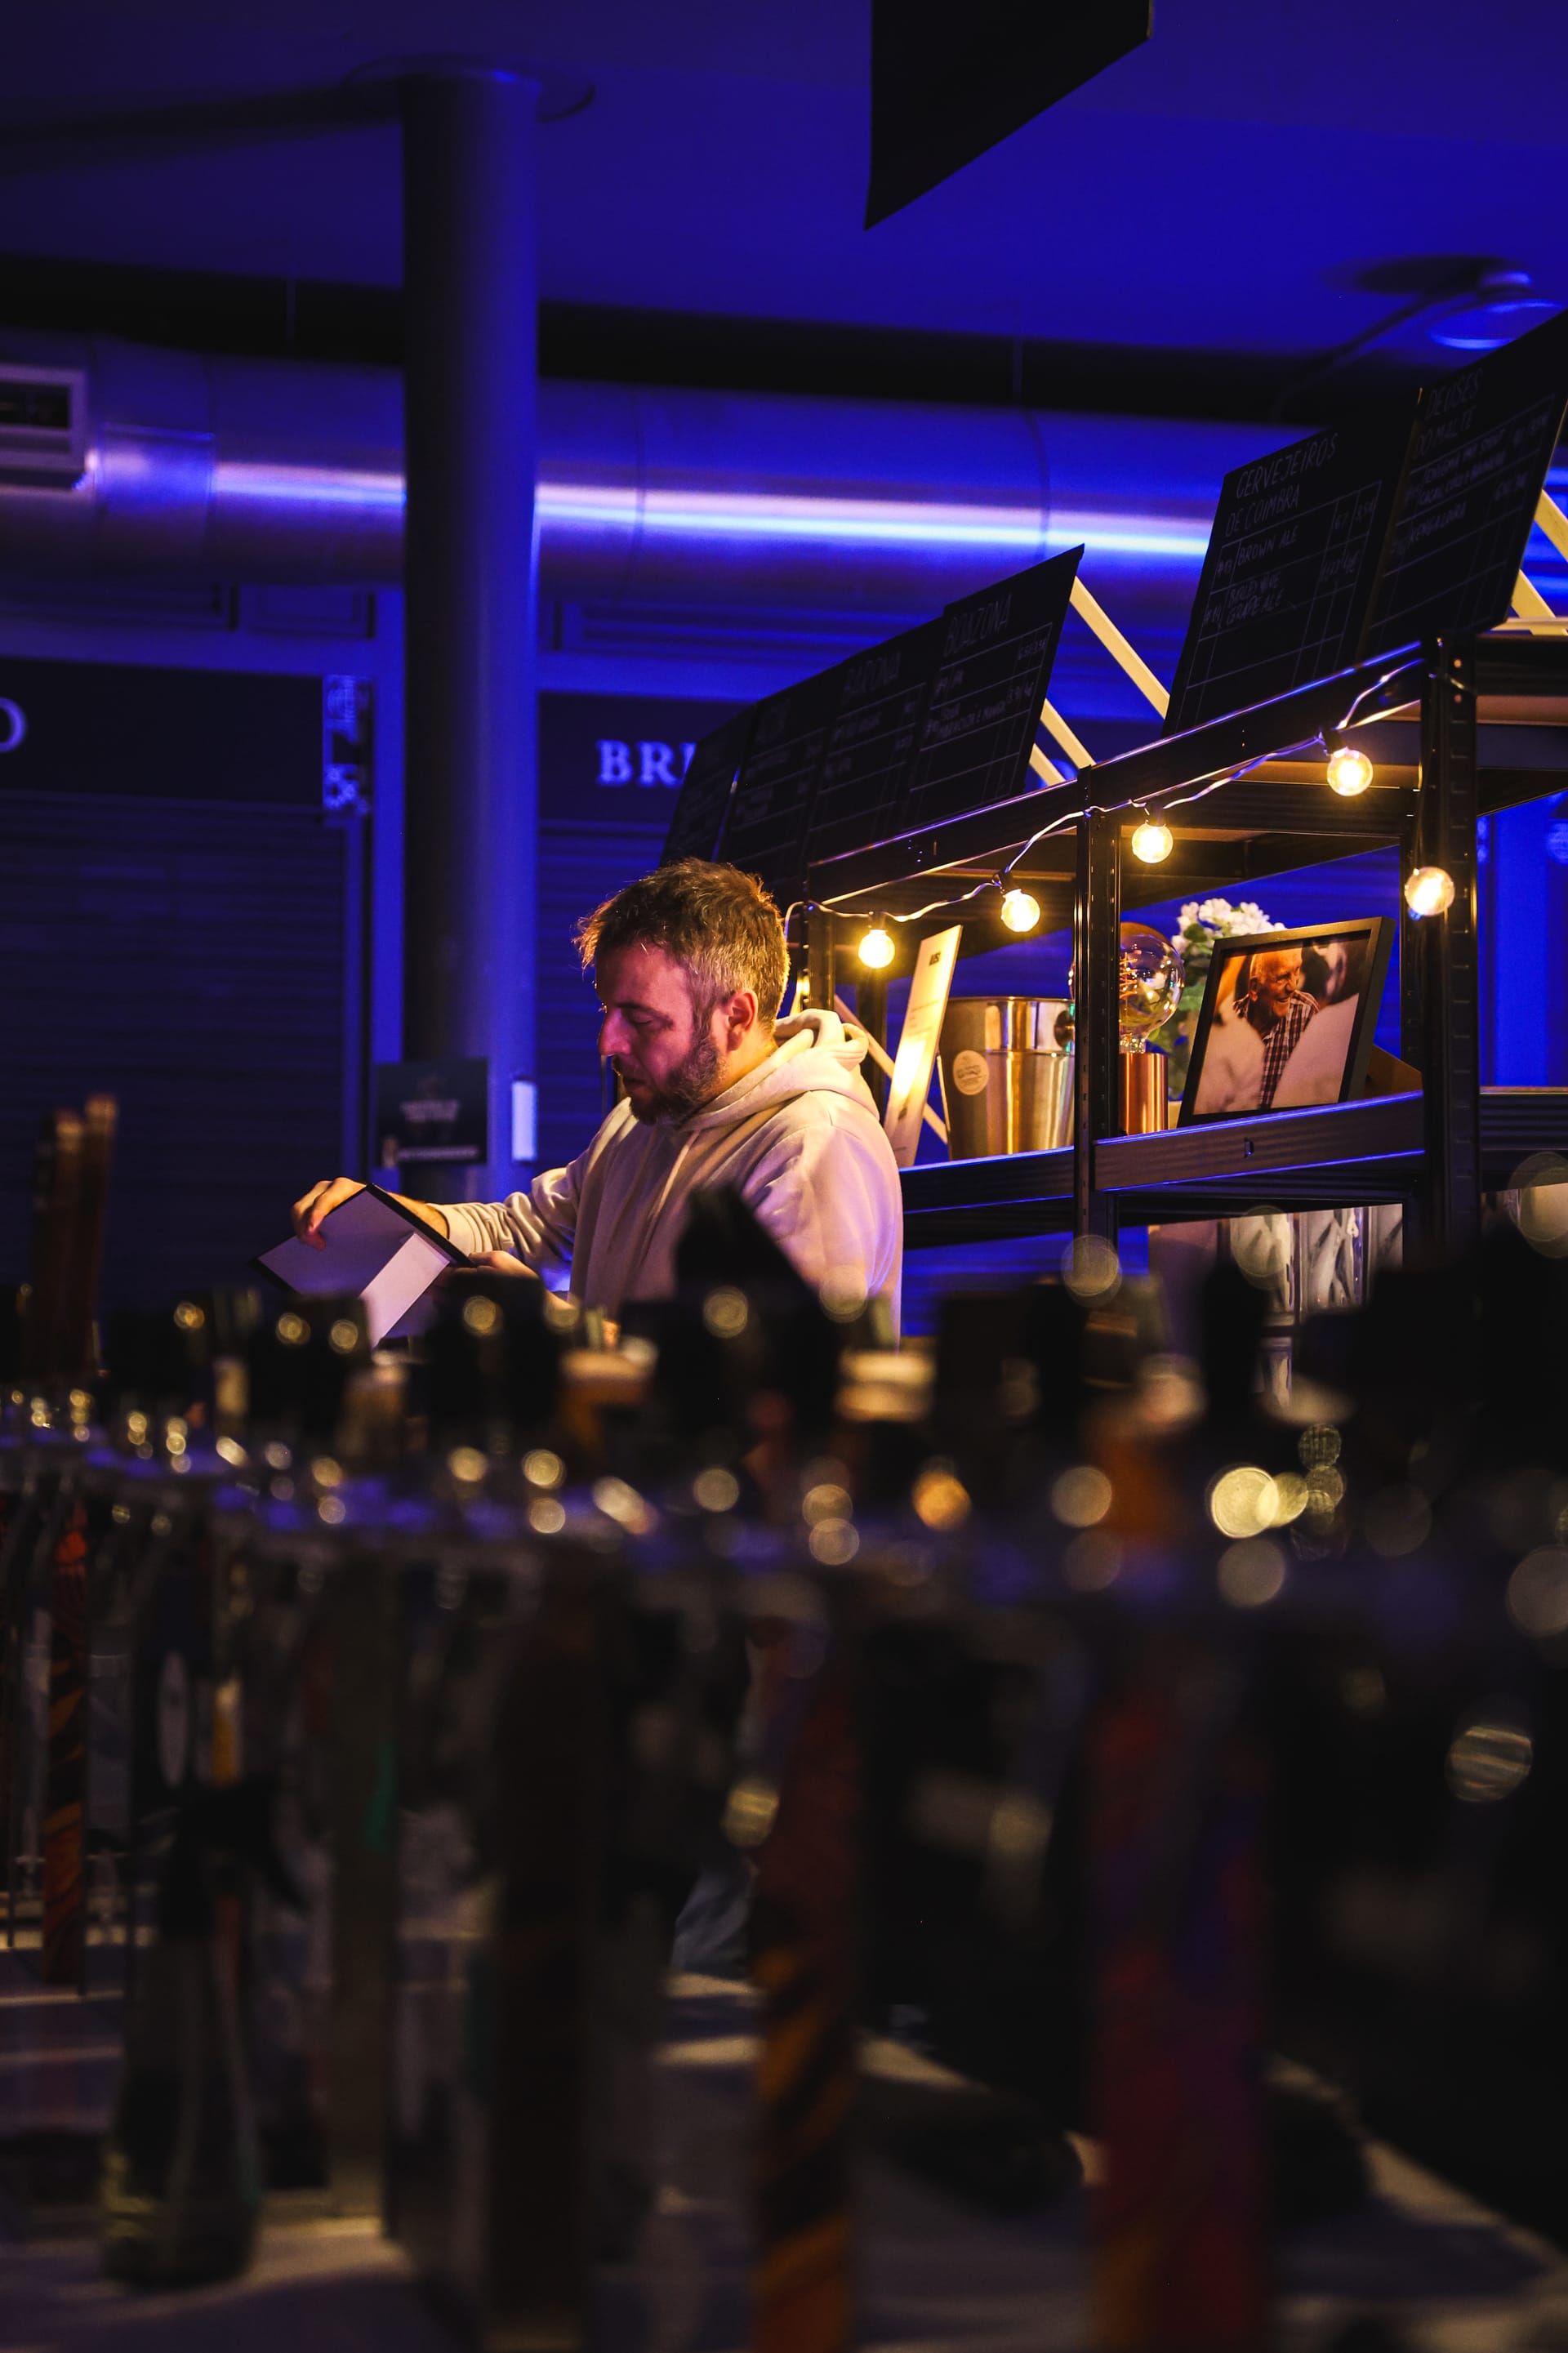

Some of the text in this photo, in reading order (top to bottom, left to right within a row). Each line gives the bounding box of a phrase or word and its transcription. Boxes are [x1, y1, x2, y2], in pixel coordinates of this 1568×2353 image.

[1425, 367, 1484, 420] DEUSES
[1236, 432, 1339, 499] CERVEJEIROS
[1225, 484, 1300, 537] DE COIMBRA
[1237, 536, 1275, 567] BROWN
[1279, 525, 1300, 549] ALE
[1261, 588, 1285, 613] ALE
